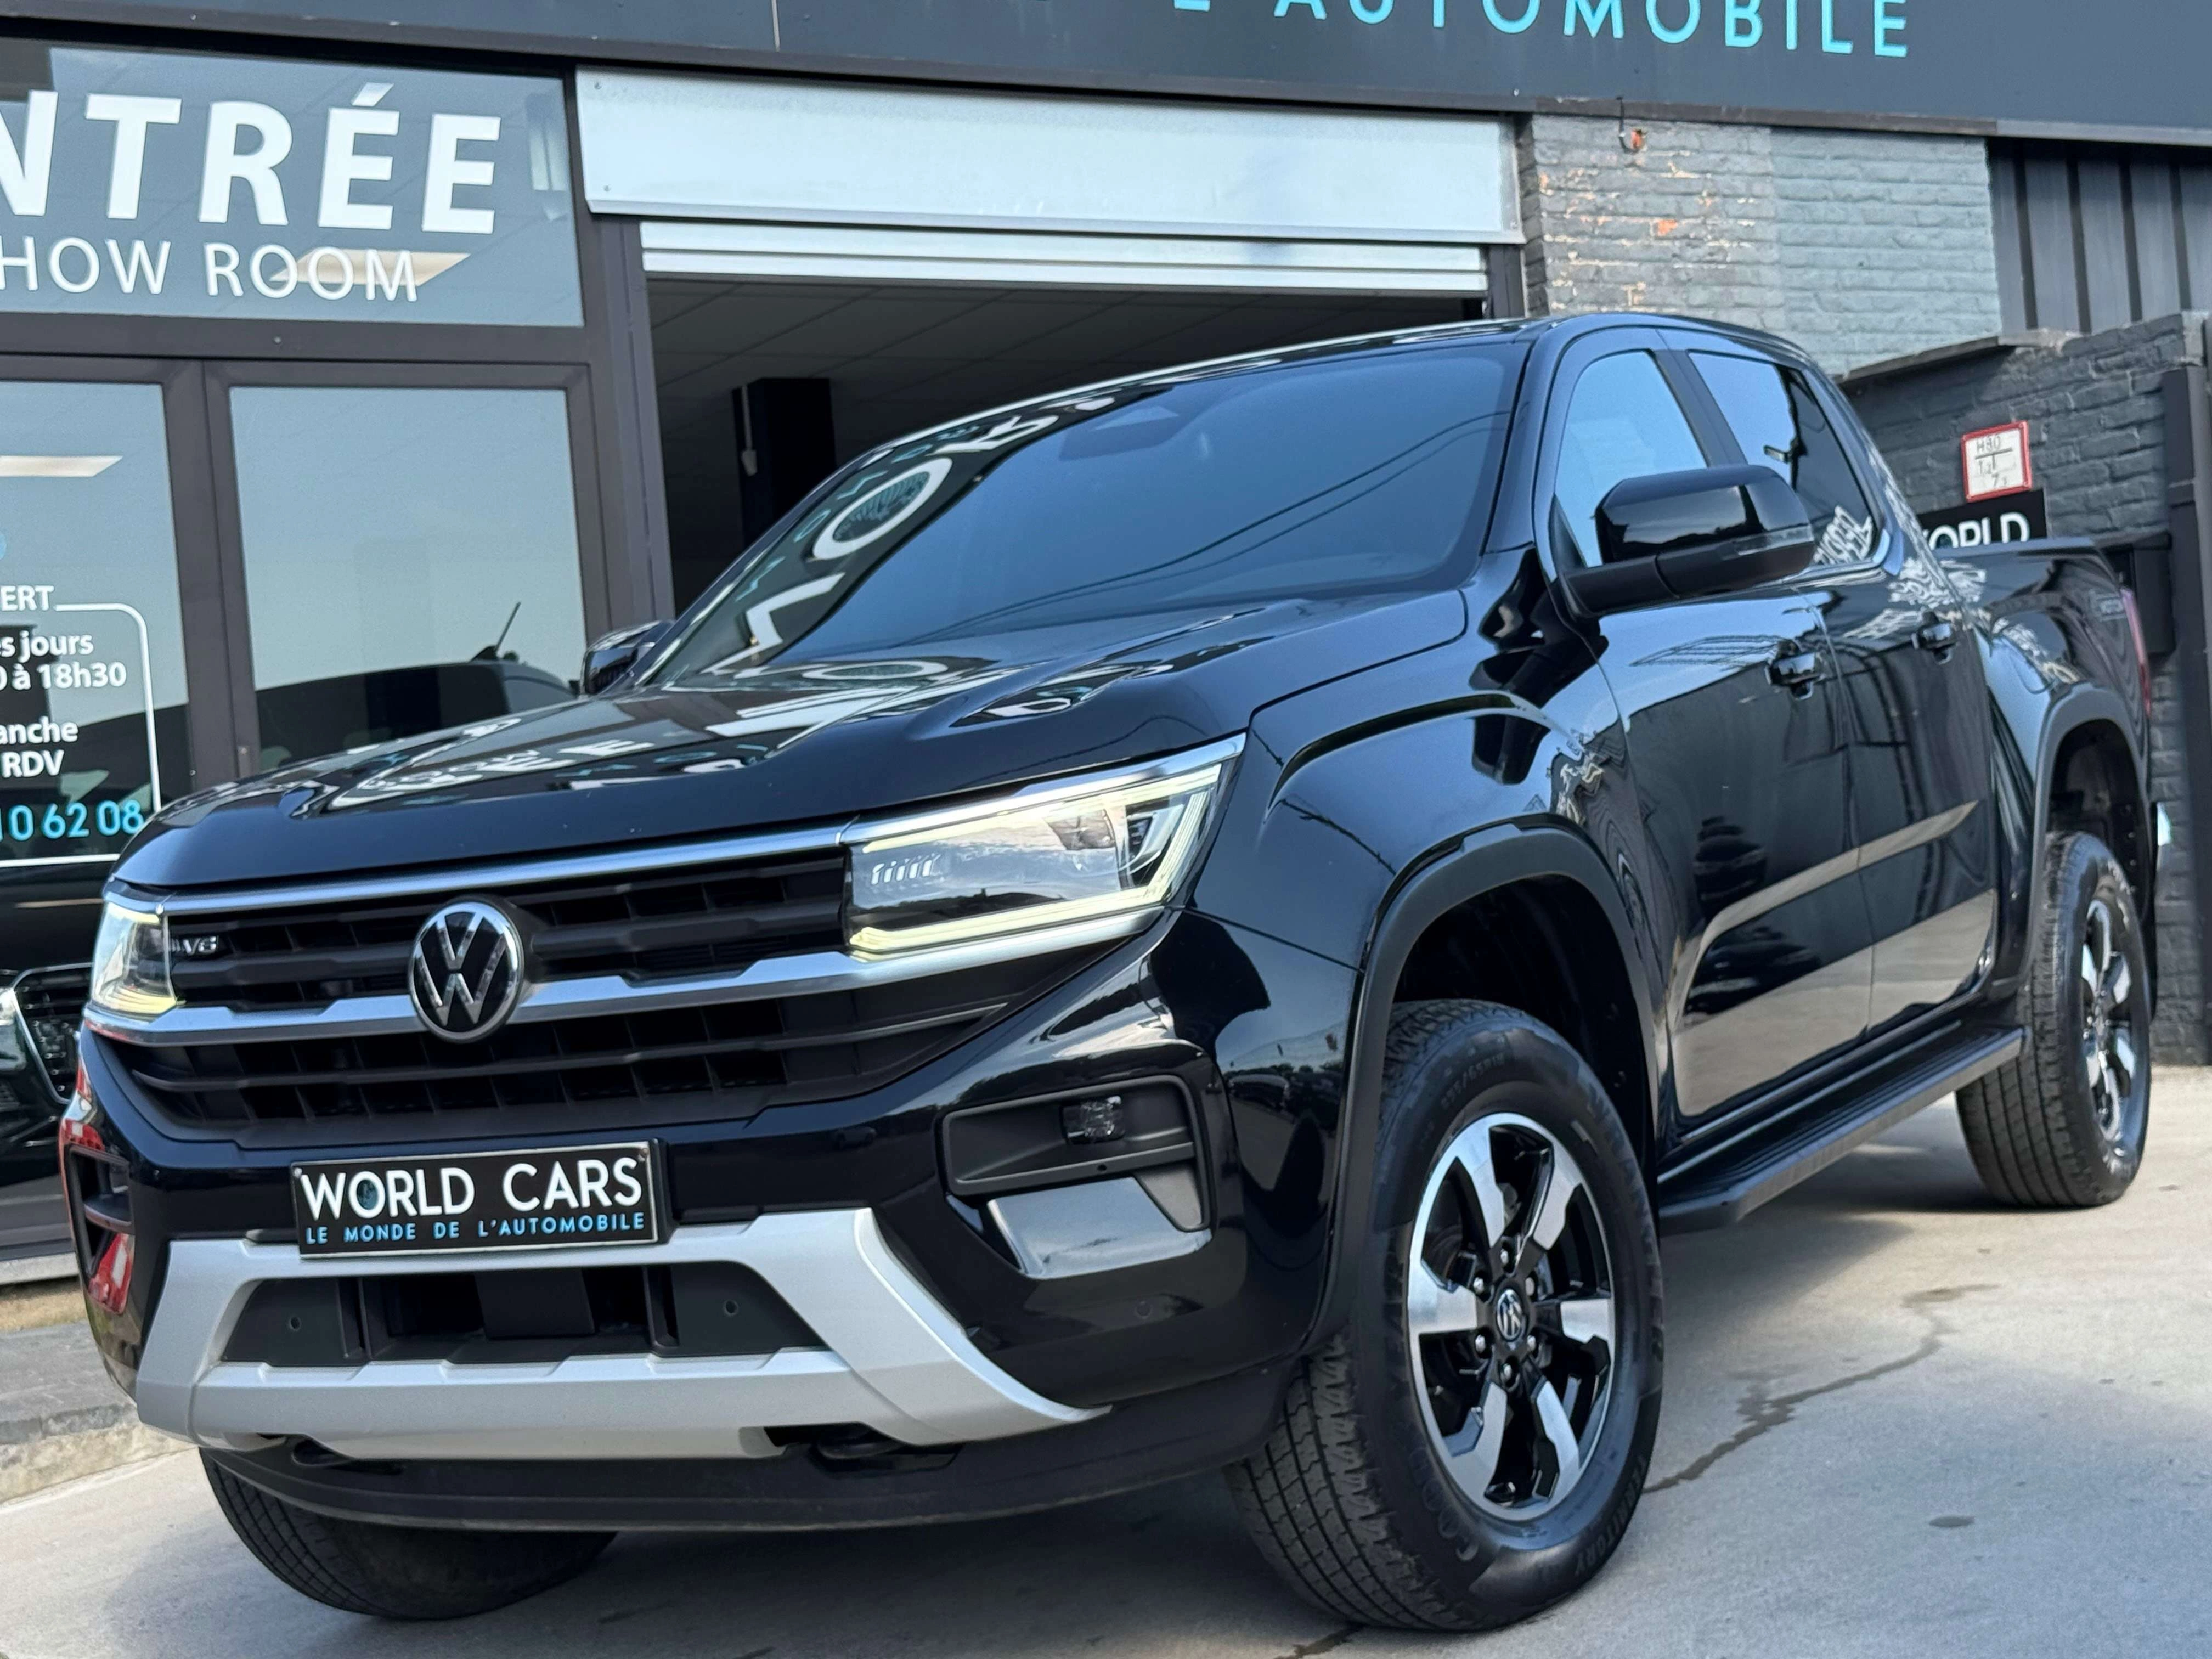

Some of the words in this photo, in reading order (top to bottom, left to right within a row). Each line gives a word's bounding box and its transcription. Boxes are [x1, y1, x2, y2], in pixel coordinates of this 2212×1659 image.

[202, 242, 419, 302] ROOM
[0, 585, 54, 611] ERT
[18, 630, 94, 663] jours
[12, 663, 31, 690] à
[36, 661, 127, 689] 18h30
[2, 749, 65, 778] RDV
[43, 802, 89, 839] 62
[96, 799, 144, 836] 08
[300, 1166, 475, 1221] WORLD
[502, 1156, 642, 1212] CARS
[306, 1226, 328, 1245] LE
[343, 1222, 416, 1243] MONDE
[433, 1221, 460, 1239] DE
[478, 1211, 645, 1237] L'AUTOMOBILE
